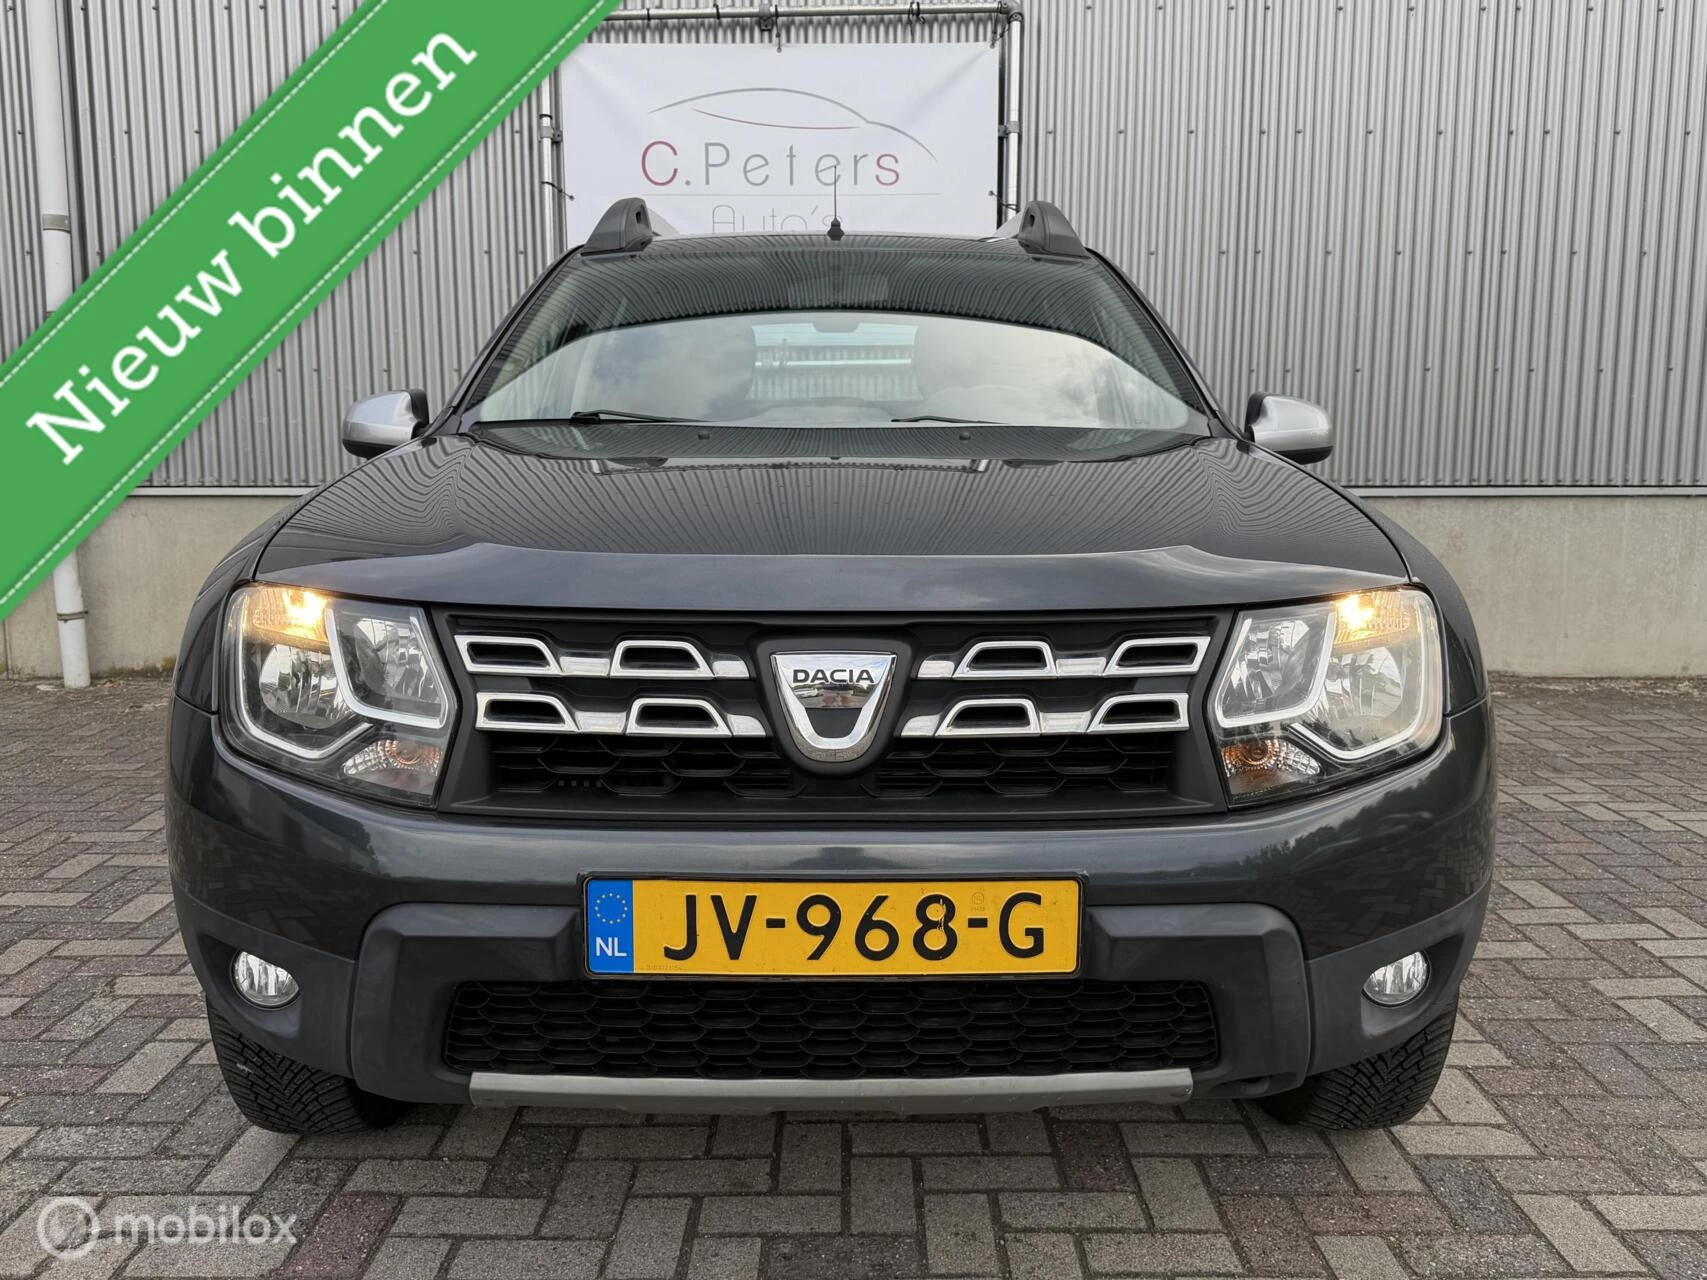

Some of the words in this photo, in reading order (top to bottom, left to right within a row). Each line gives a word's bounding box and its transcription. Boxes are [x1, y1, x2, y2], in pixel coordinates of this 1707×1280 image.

[792, 668, 875, 684] DACIA
[663, 892, 1045, 962] JV-968-G
[595, 937, 627, 958] NL
